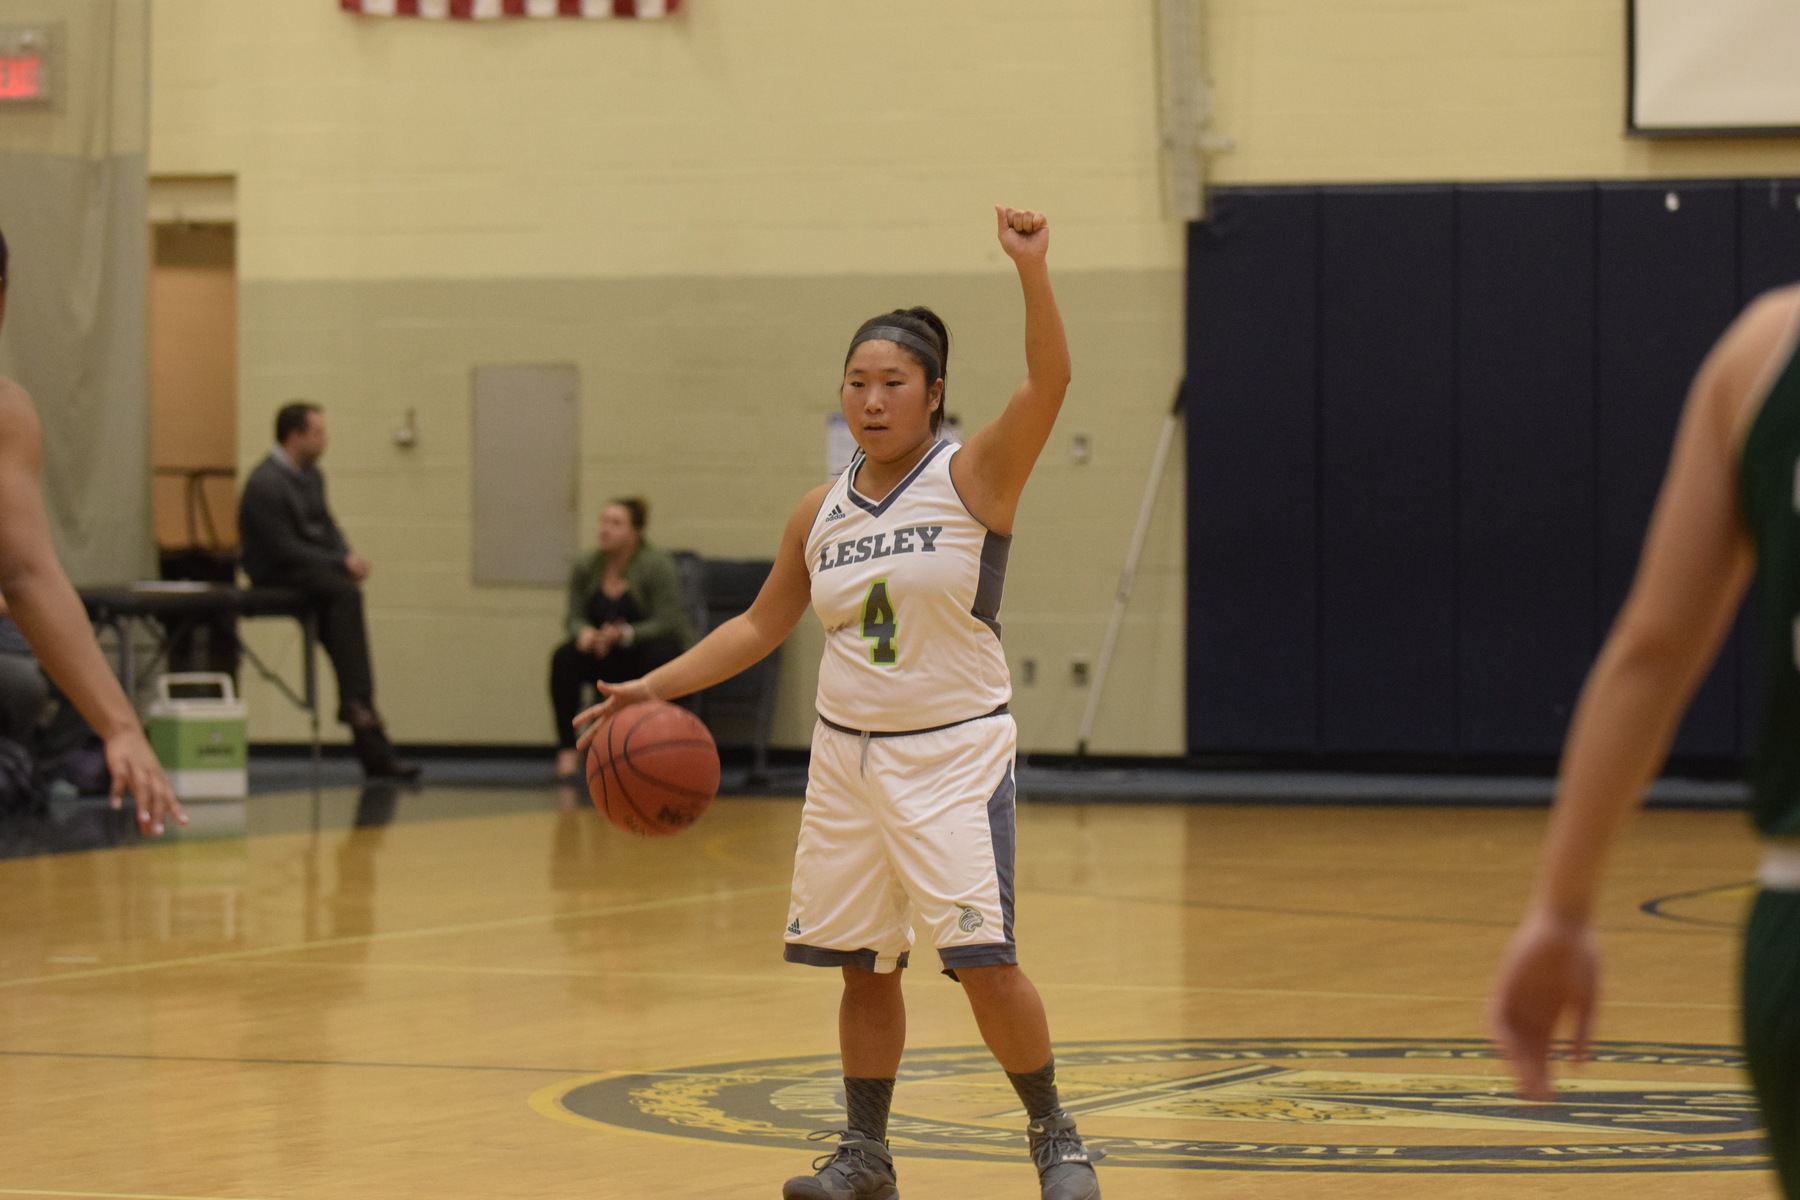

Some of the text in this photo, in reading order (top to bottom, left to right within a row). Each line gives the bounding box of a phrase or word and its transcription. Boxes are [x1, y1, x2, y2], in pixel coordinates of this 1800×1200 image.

[825, 512, 846, 523] adidas
[819, 526, 943, 572] LESLEY
[860, 578, 898, 666] 4
